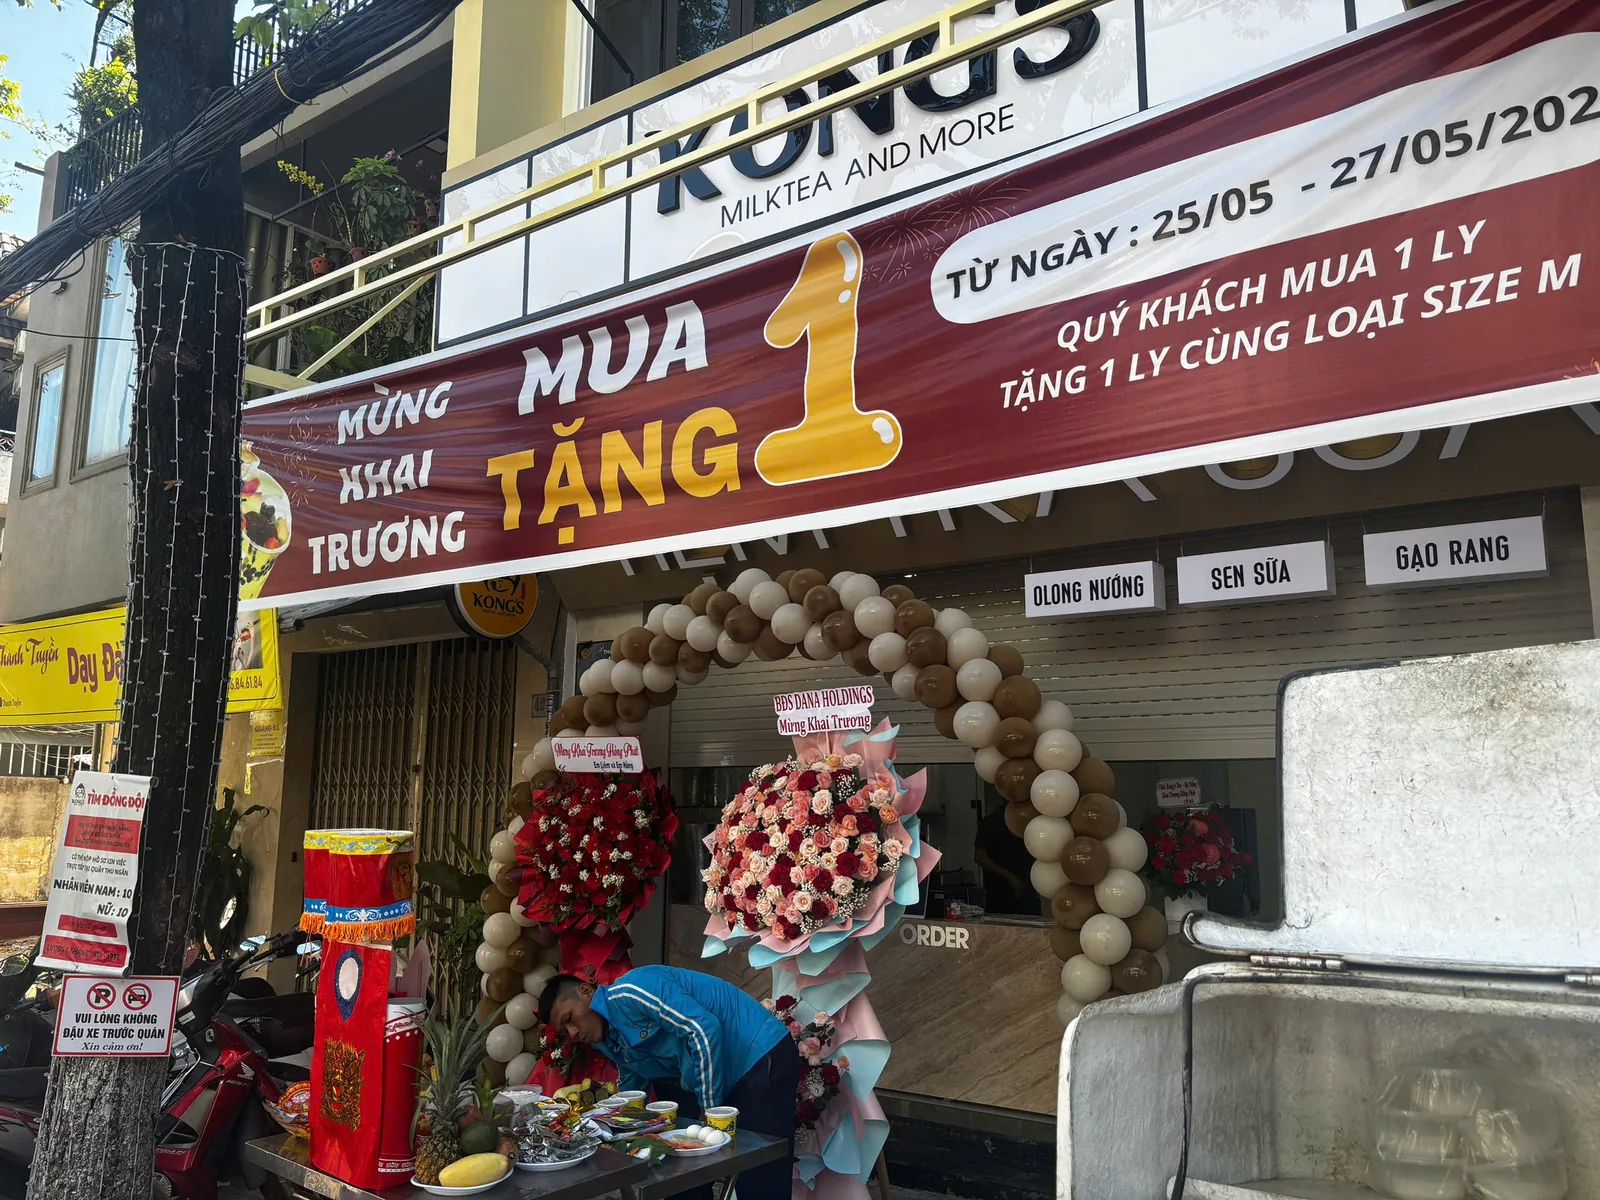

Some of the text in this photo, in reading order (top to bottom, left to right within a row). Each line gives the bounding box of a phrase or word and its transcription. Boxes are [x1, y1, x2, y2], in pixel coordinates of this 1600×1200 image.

[721, 103, 1014, 228] MILKTEA AND MORE
[946, 257, 999, 299] TỪ
[1010, 226, 1118, 282] NGÀY
[1152, 180, 1273, 241] 25/05
[1057, 219, 1486, 353] QUÝ KHÁCH MUA 1 LY
[1000, 253, 1582, 412] TẶNG 1 LY CÙNG LOẠI SIZE M
[517, 301, 708, 415] MUA
[755, 231, 903, 486] 1
[337, 381, 453, 445] MỪNG
[339, 449, 433, 504] KHAI
[487, 407, 740, 544] TẶNG
[308, 511, 466, 575] TRƯƠNG
[1396, 535, 1510, 572] GẠO RANG
[1033, 573, 1144, 606] OLONG NƯỚNG
[1211, 557, 1291, 590] SEN SỮA
[67, 647, 98, 693] Dạy
[775, 686, 872, 711] BĐS DANA HOLDINGS
[780, 714, 870, 735] Mừng Khai Trương
[88, 789, 101, 805] TÌM
[54, 877, 79, 892] NHÂN
[79, 880, 94, 894] VIÊN
[95, 886, 116, 897] NAM
[122, 889, 132, 899] 10
[116, 908, 129, 918] 10
[900, 923, 969, 949] ORDER
[63, 1026, 165, 1040] ĐẬU XE TRƯỚC QUÁN
[75, 1012, 158, 1024] VUI LÒNG KHÔNG
[82, 1042, 144, 1051] Xin cảm ơn!
